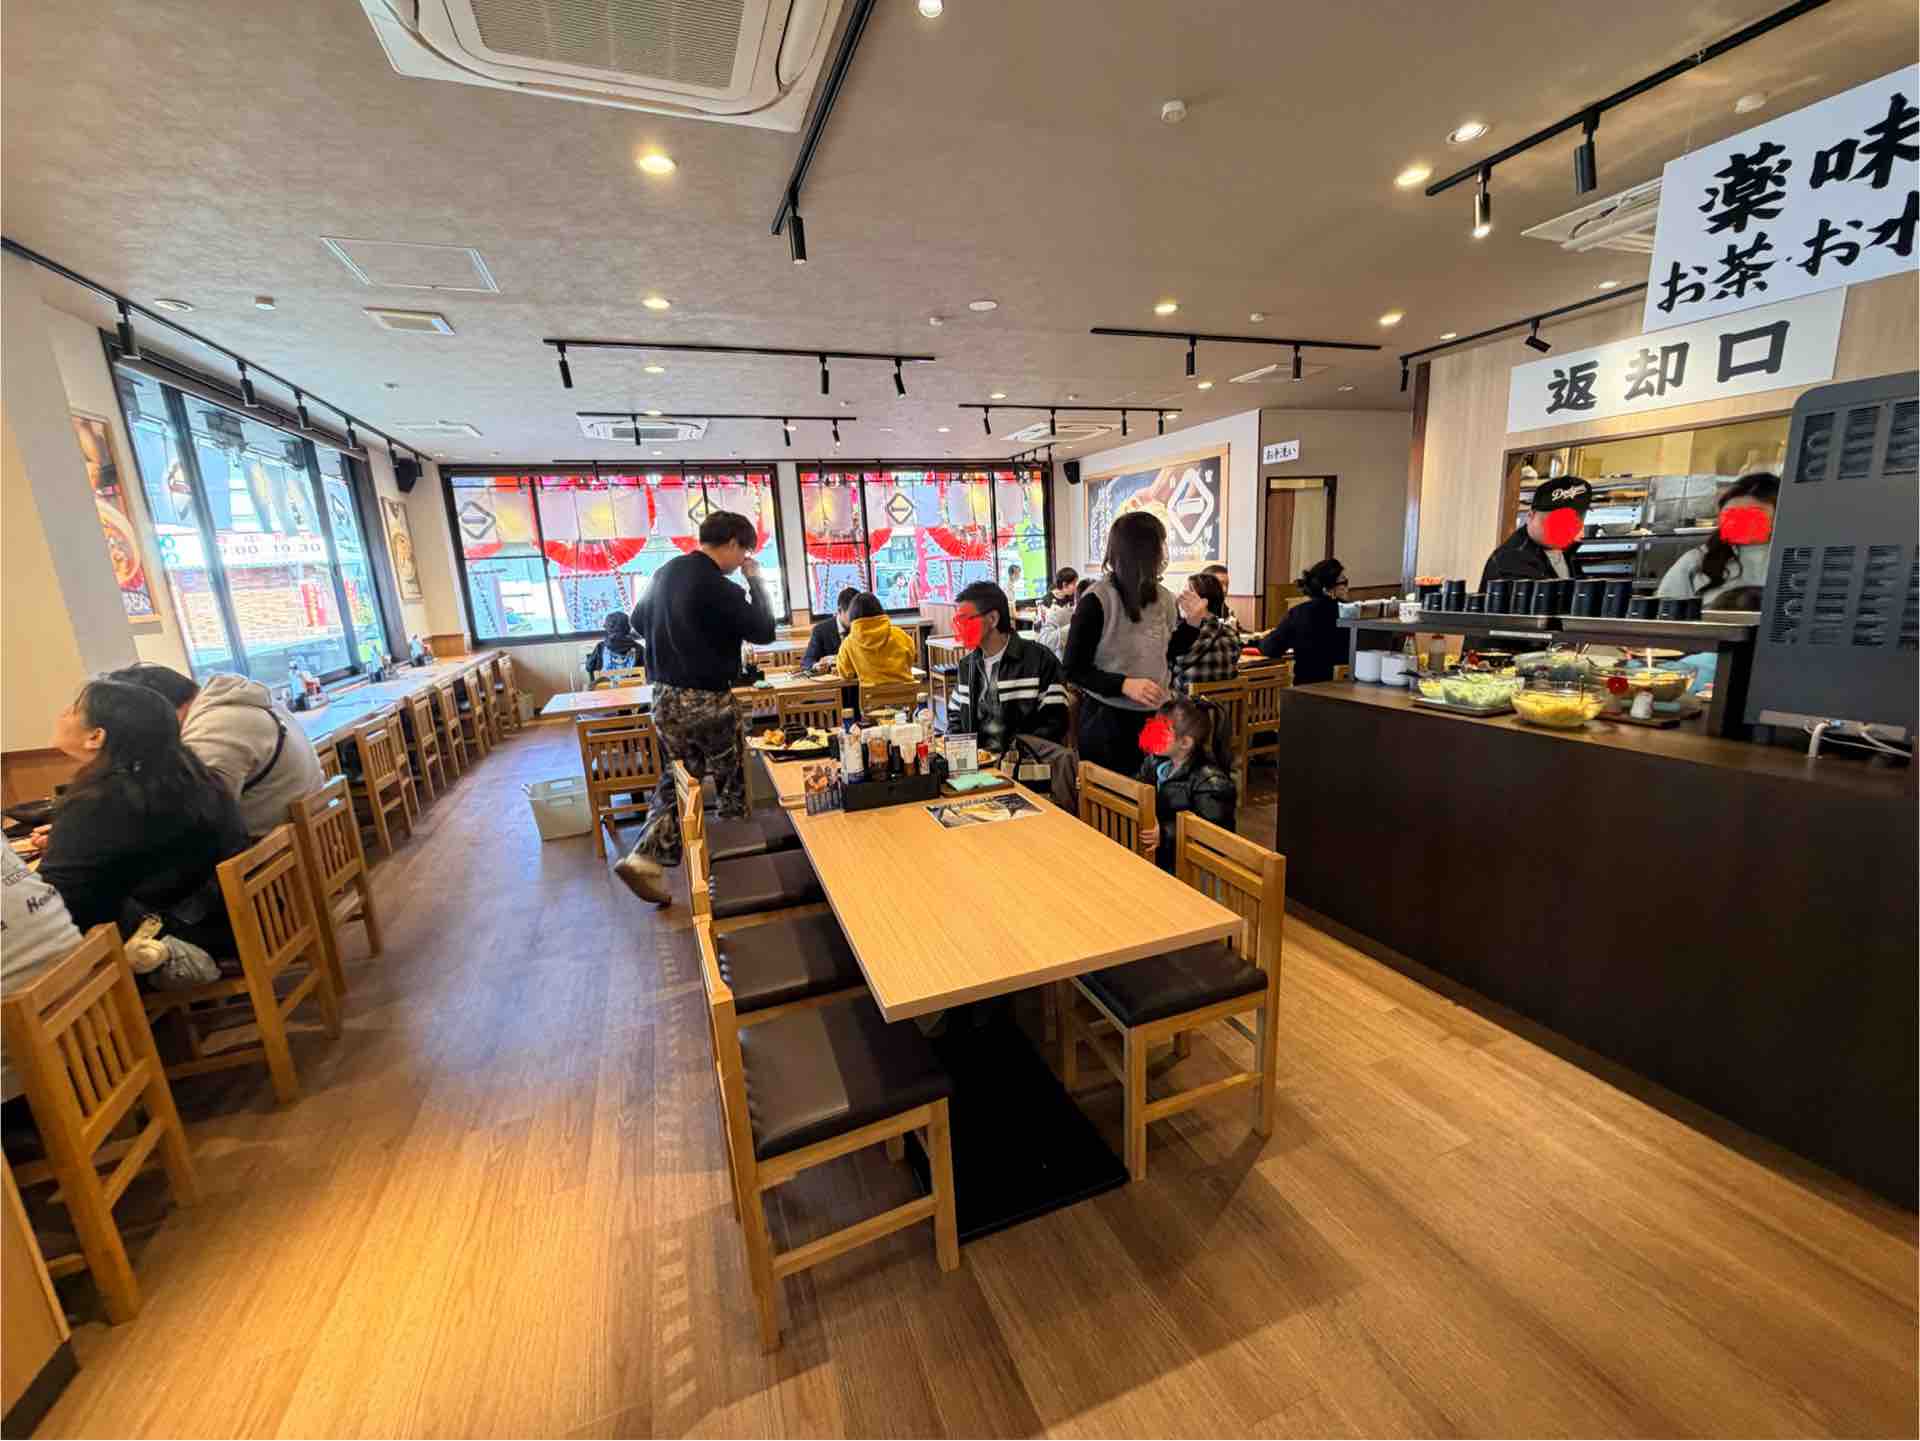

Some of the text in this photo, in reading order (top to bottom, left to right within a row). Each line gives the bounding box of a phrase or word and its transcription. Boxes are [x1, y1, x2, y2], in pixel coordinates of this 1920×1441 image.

[1698, 92, 1919, 233] 薬味
[1546, 320, 1791, 415] 返却口
